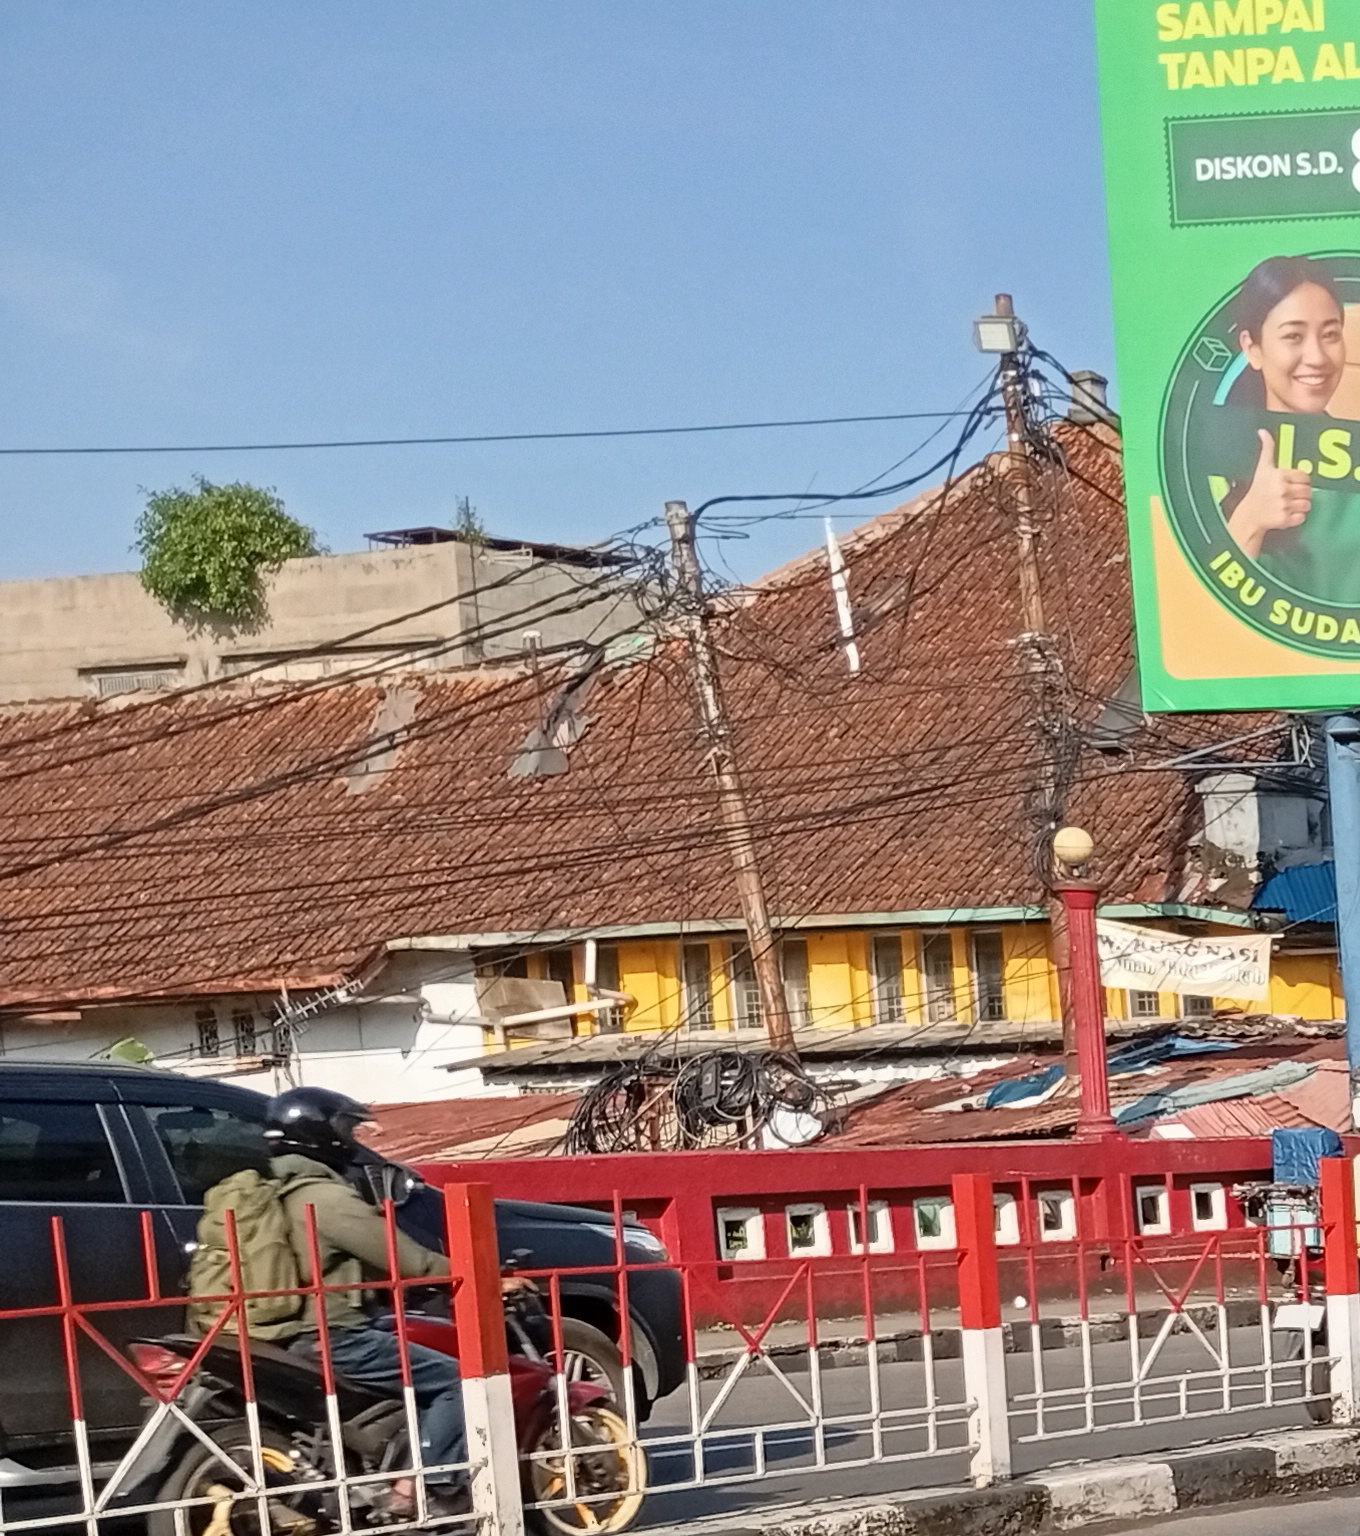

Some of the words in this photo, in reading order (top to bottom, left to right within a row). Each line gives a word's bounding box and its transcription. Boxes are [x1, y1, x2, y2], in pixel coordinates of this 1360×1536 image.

[1157, 0, 1325, 41] SAMPAI
[1158, 46, 1305, 90] TANPA
[1195, 153, 1291, 181] DISKON
[1296, 151, 1344, 176] S.D.
[1209, 550, 1266, 606] IBU
